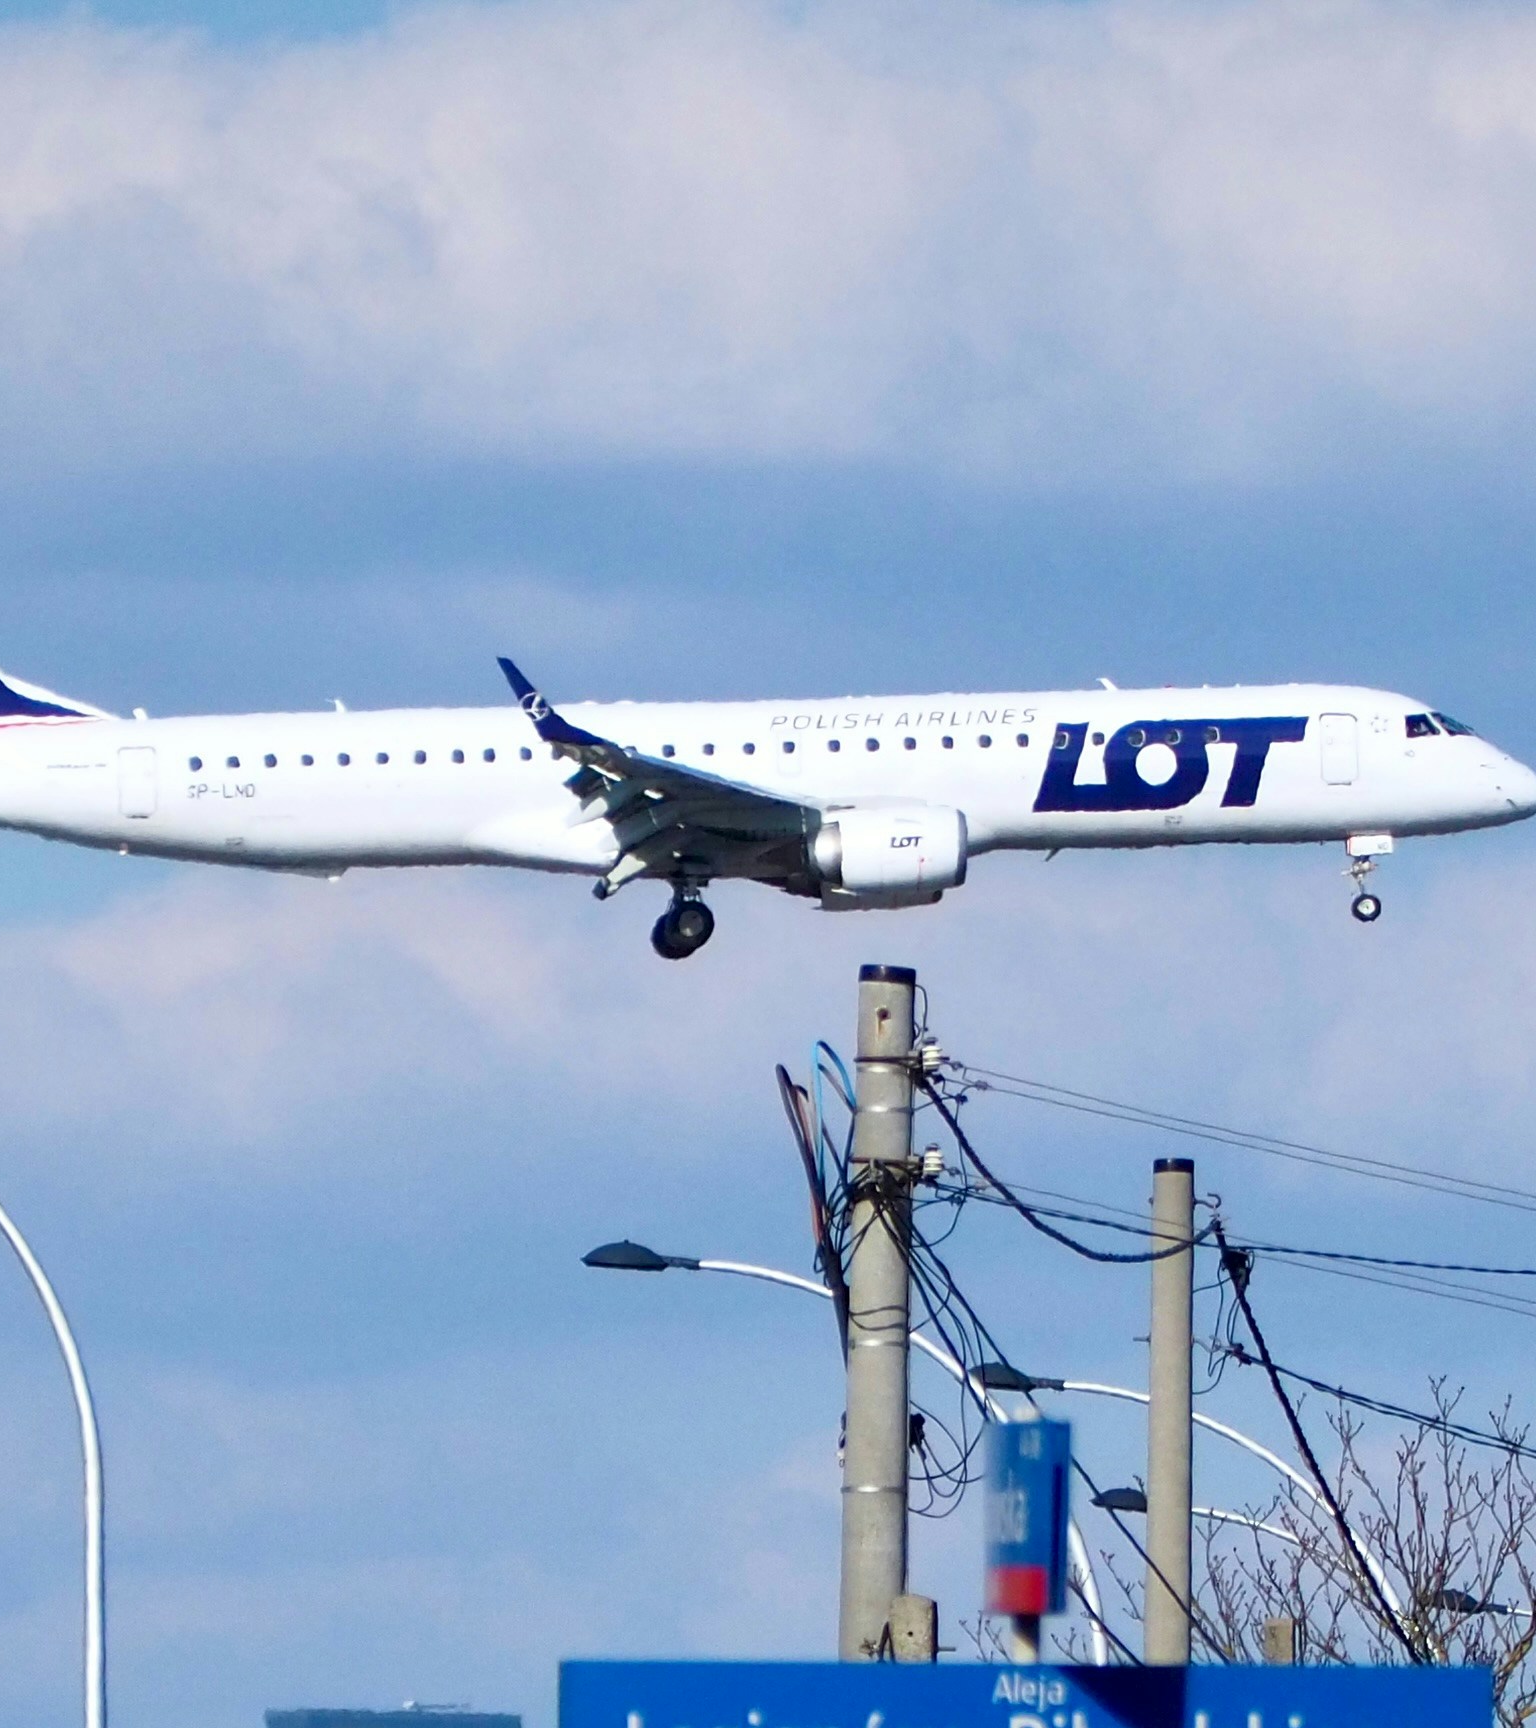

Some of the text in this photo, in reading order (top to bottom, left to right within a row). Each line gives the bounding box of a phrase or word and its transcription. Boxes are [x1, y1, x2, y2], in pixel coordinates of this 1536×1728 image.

[770, 707, 1039, 731] POLISH AIRLINES
[1032, 716, 1310, 812] LOT
[890, 836, 923, 848] LOT
[992, 1674, 1065, 1710] Aleja
